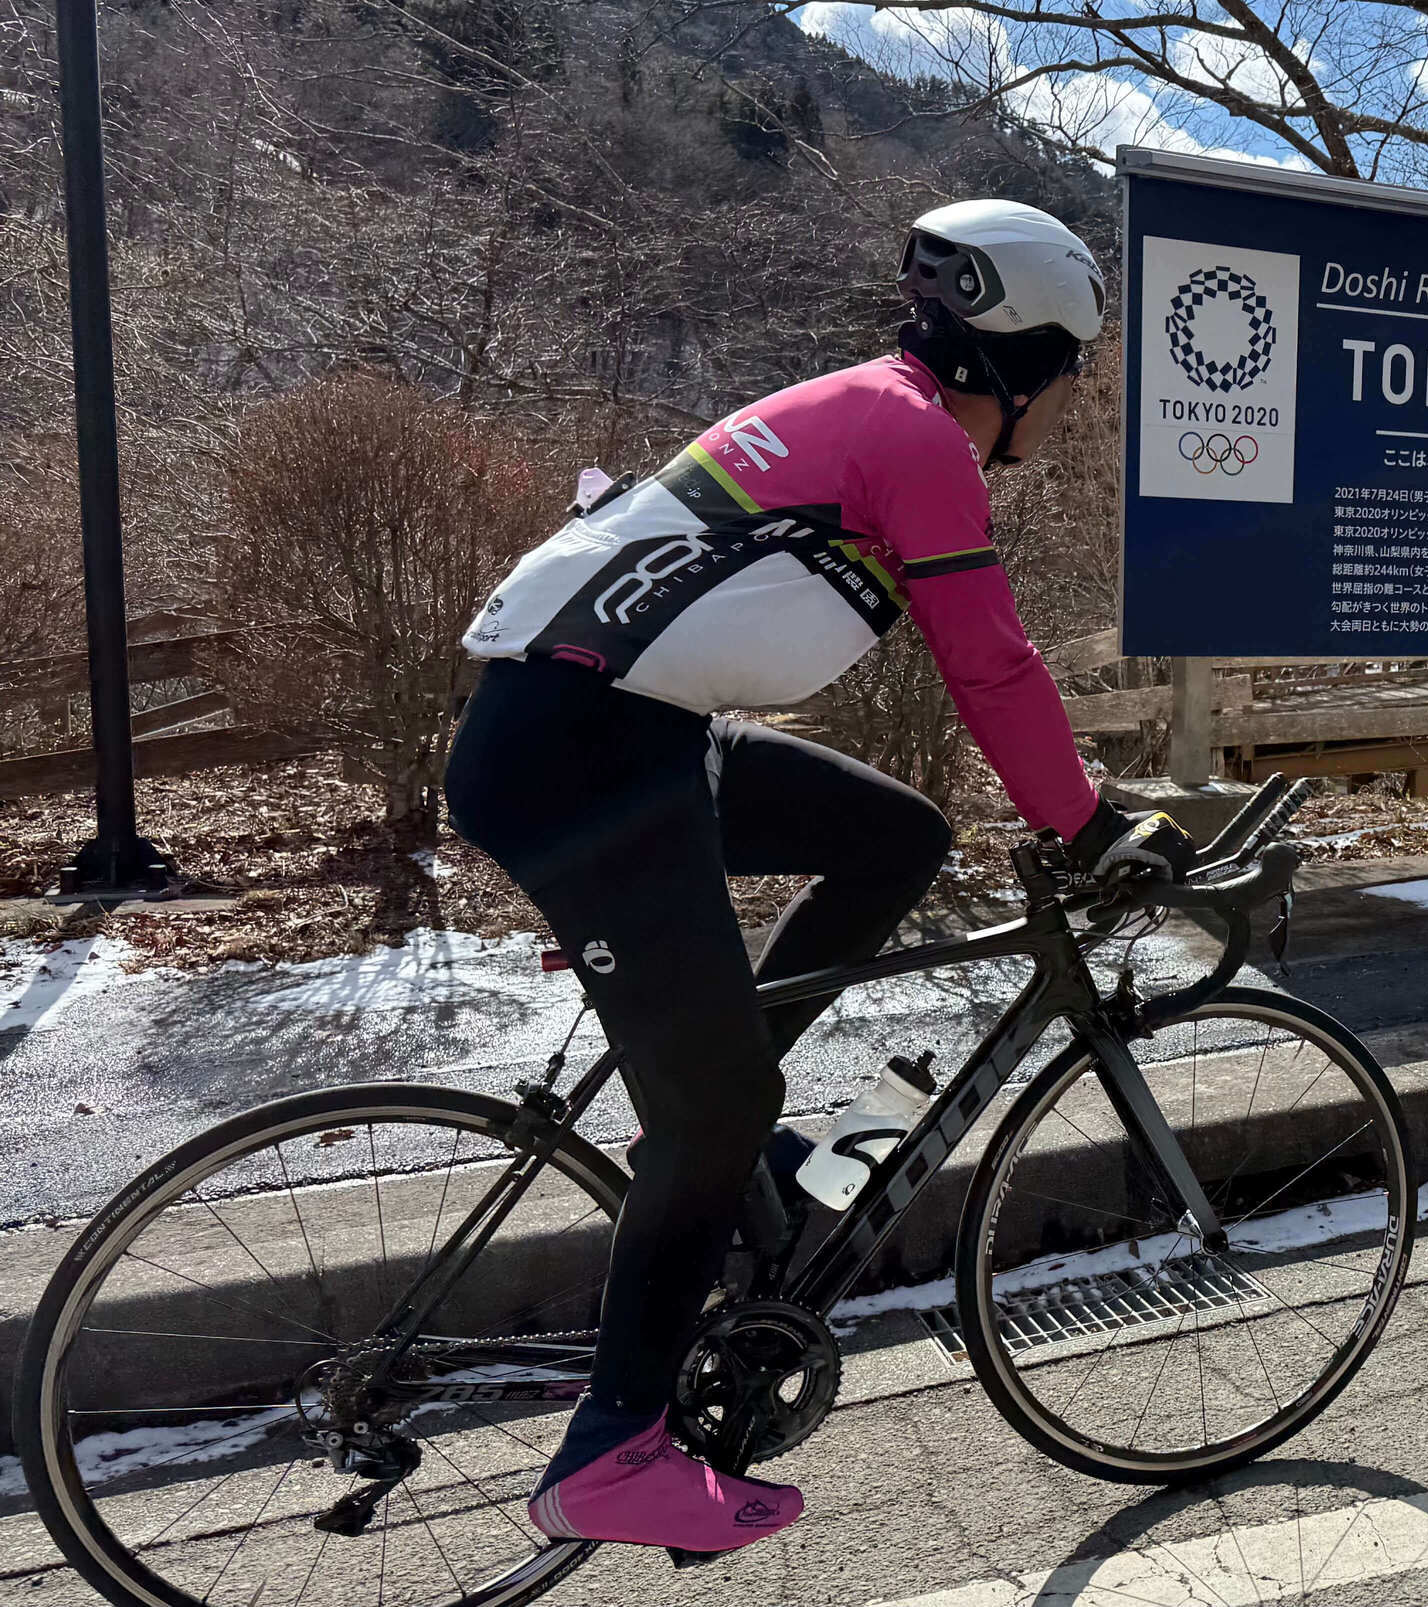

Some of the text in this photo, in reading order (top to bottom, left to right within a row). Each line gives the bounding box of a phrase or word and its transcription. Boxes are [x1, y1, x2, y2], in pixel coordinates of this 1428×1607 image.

[1321, 262, 1409, 302] Doshi
[1159, 398, 1279, 428] TOKYO 2020
